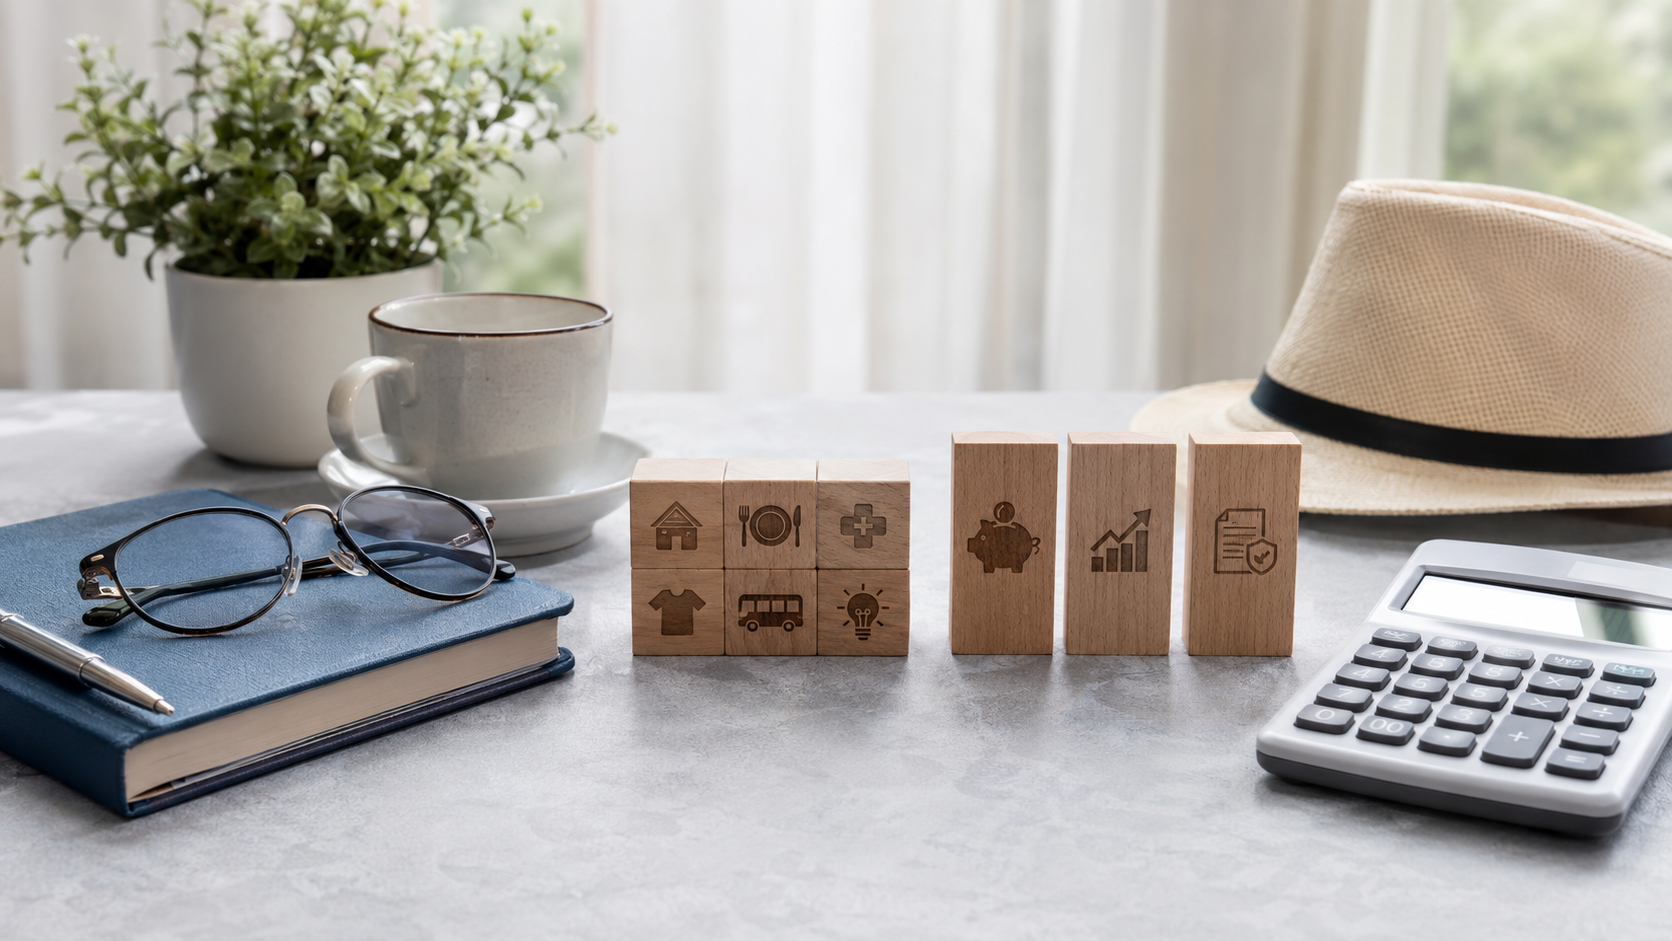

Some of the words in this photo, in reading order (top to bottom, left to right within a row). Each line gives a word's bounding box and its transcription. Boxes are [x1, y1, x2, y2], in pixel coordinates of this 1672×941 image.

[1353, 669, 1371, 679] 4
[1411, 678, 1431, 689] 5
[1337, 687, 1354, 698] 7
[1470, 688, 1490, 698] 5
[1394, 699, 1412, 711] 2
[1314, 709, 1336, 720] 0
[1453, 709, 1474, 721] 3
[1369, 718, 1404, 733] 00
